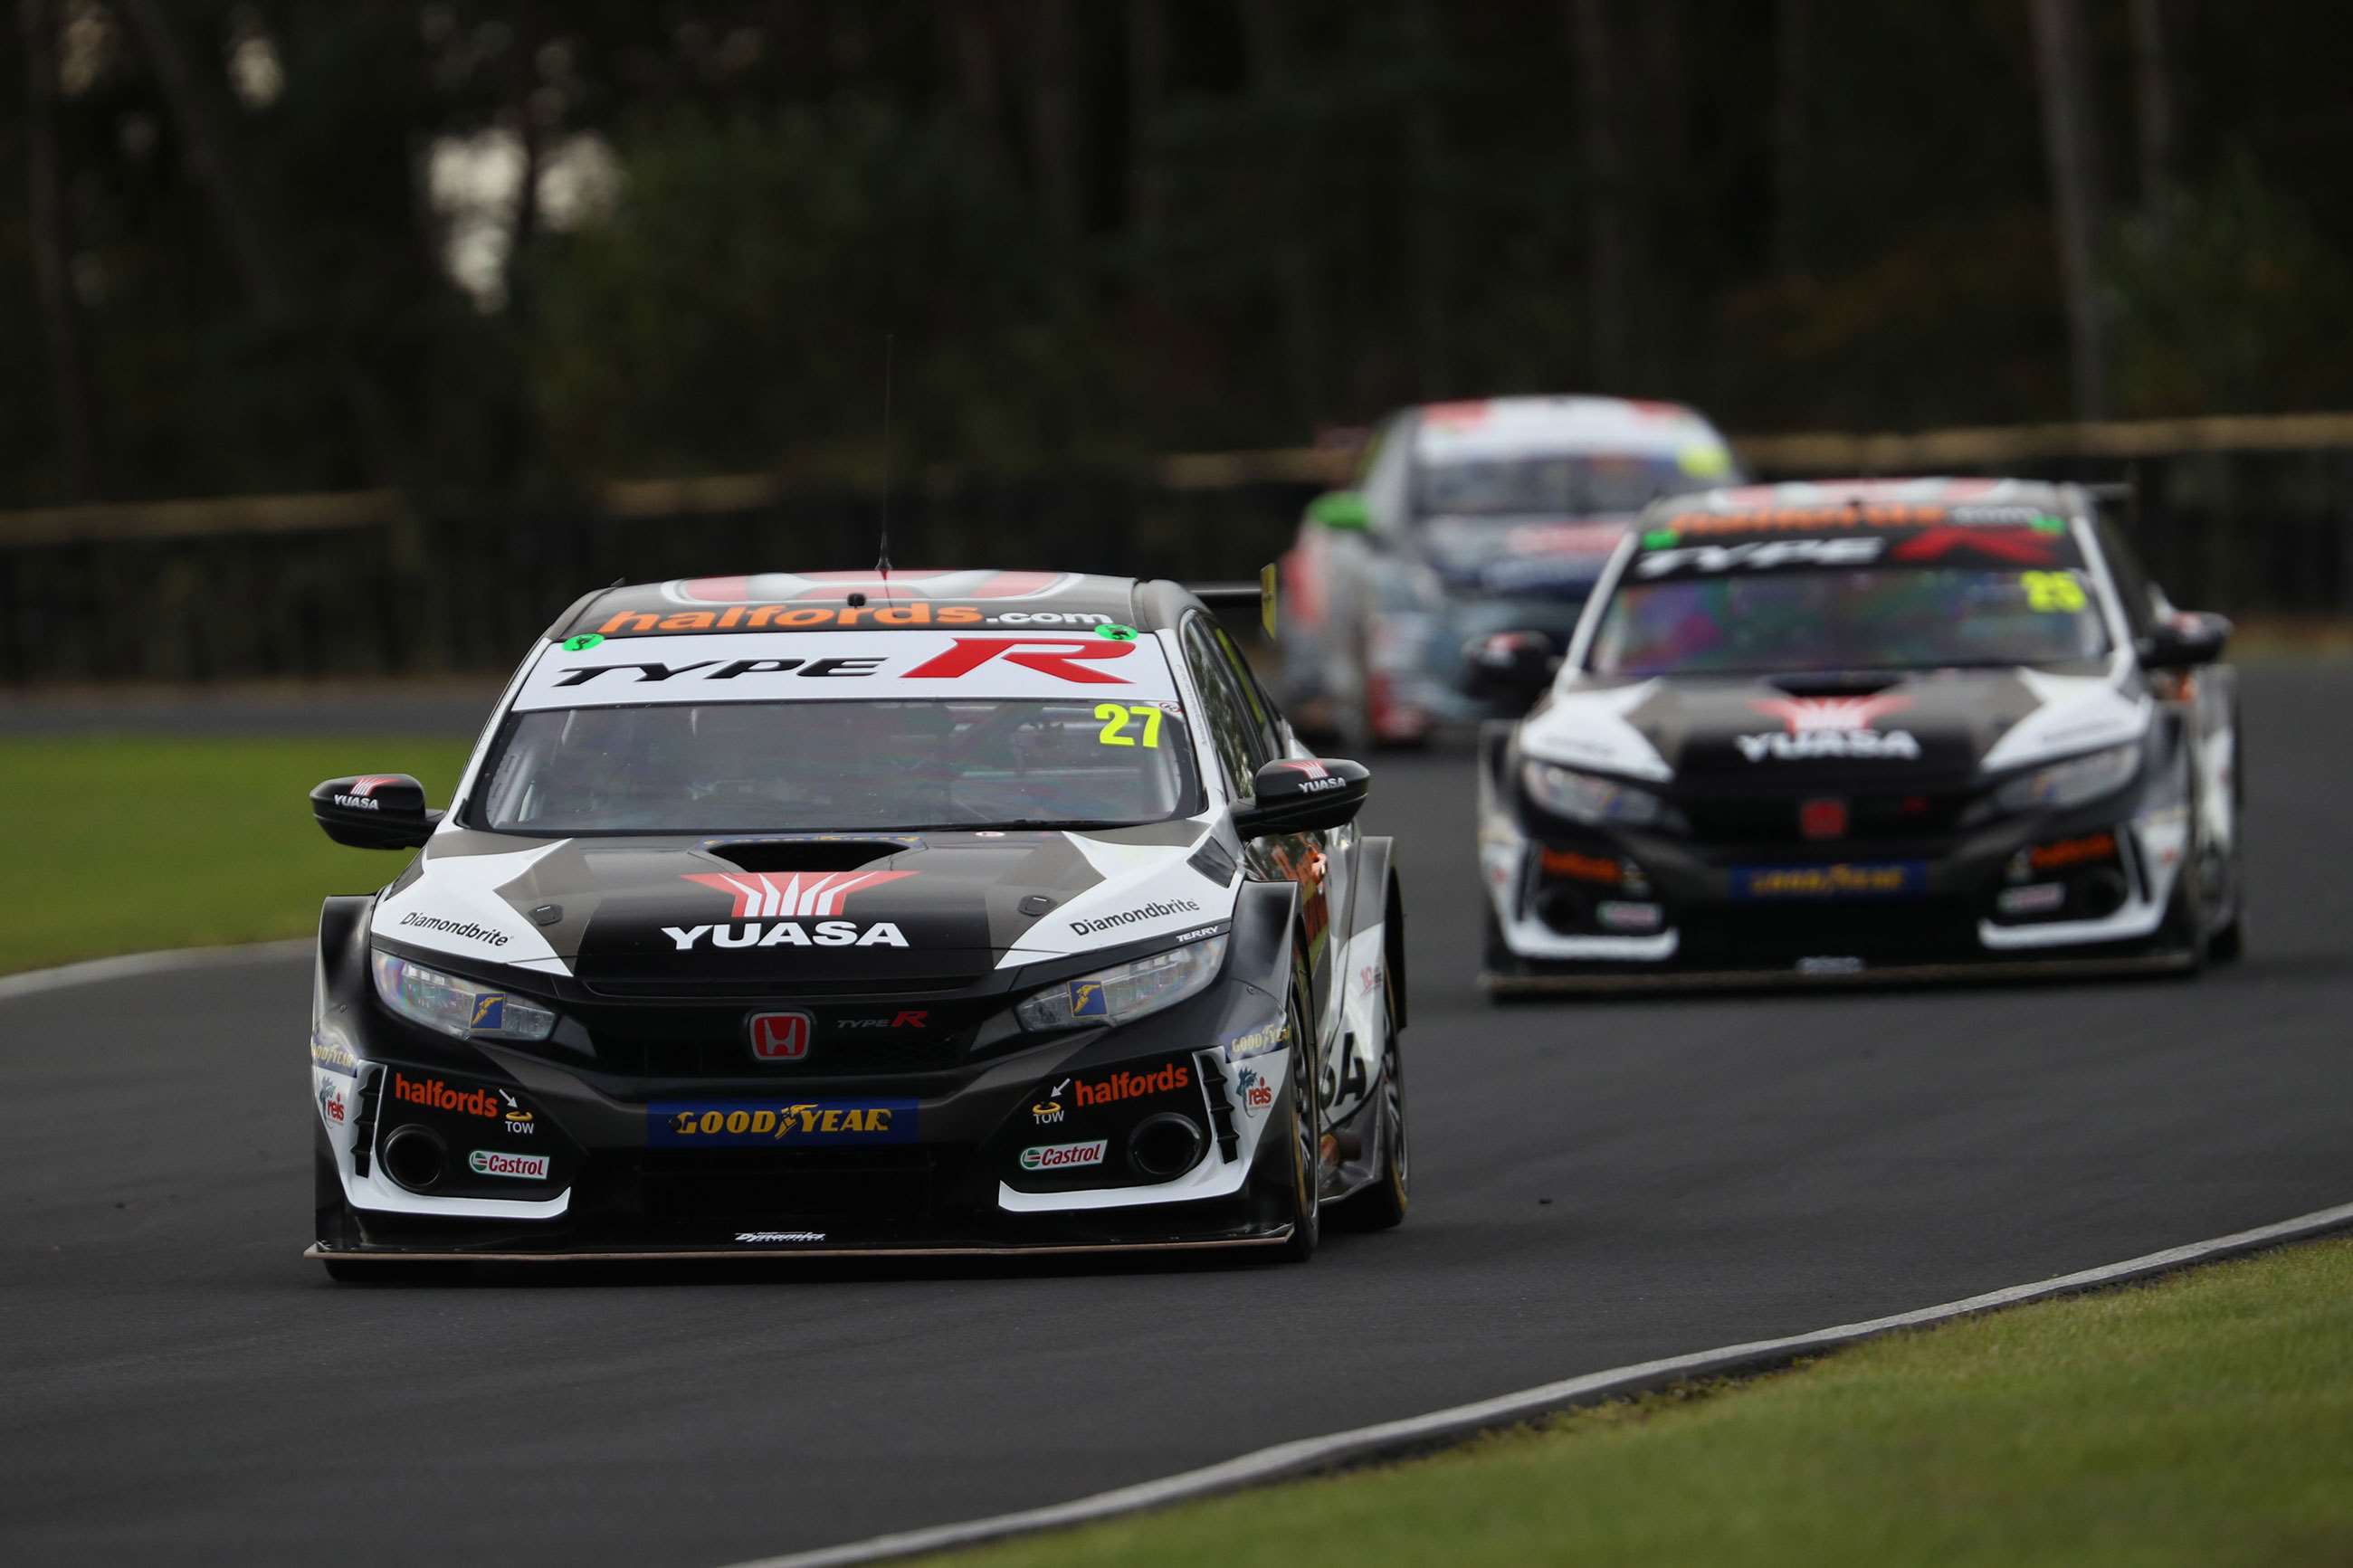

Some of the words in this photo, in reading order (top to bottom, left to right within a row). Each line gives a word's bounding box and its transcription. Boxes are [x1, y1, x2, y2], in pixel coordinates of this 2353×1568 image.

[596, 603, 1113, 634] halfords.com
[551, 656, 890, 688] TYPE
[898, 637, 1137, 684] R
[1093, 703, 1162, 748] 27
[1735, 729, 1921, 763] YUASA
[1298, 776, 1347, 794] YUASA
[334, 794, 380, 811] YUASA
[399, 911, 510, 947] Diamondbrite
[1069, 898, 1201, 936] Diamondbrite
[660, 920, 910, 951] YUASA
[1176, 925, 1219, 943] TERRY
[836, 1019, 891, 1029] TYPE
[890, 1010, 928, 1029] R
[395, 1072, 499, 1118] halfords
[1074, 1063, 1189, 1108] halfords
[1249, 1076, 1272, 1106] reis
[327, 1091, 345, 1122] reis
[675, 1105, 891, 1137] GOODYEAR
[1034, 1109, 1064, 1125] TOW
[505, 1120, 534, 1135] TOW
[488, 1155, 544, 1175] Castrol
[1041, 1144, 1100, 1166] Castrol
